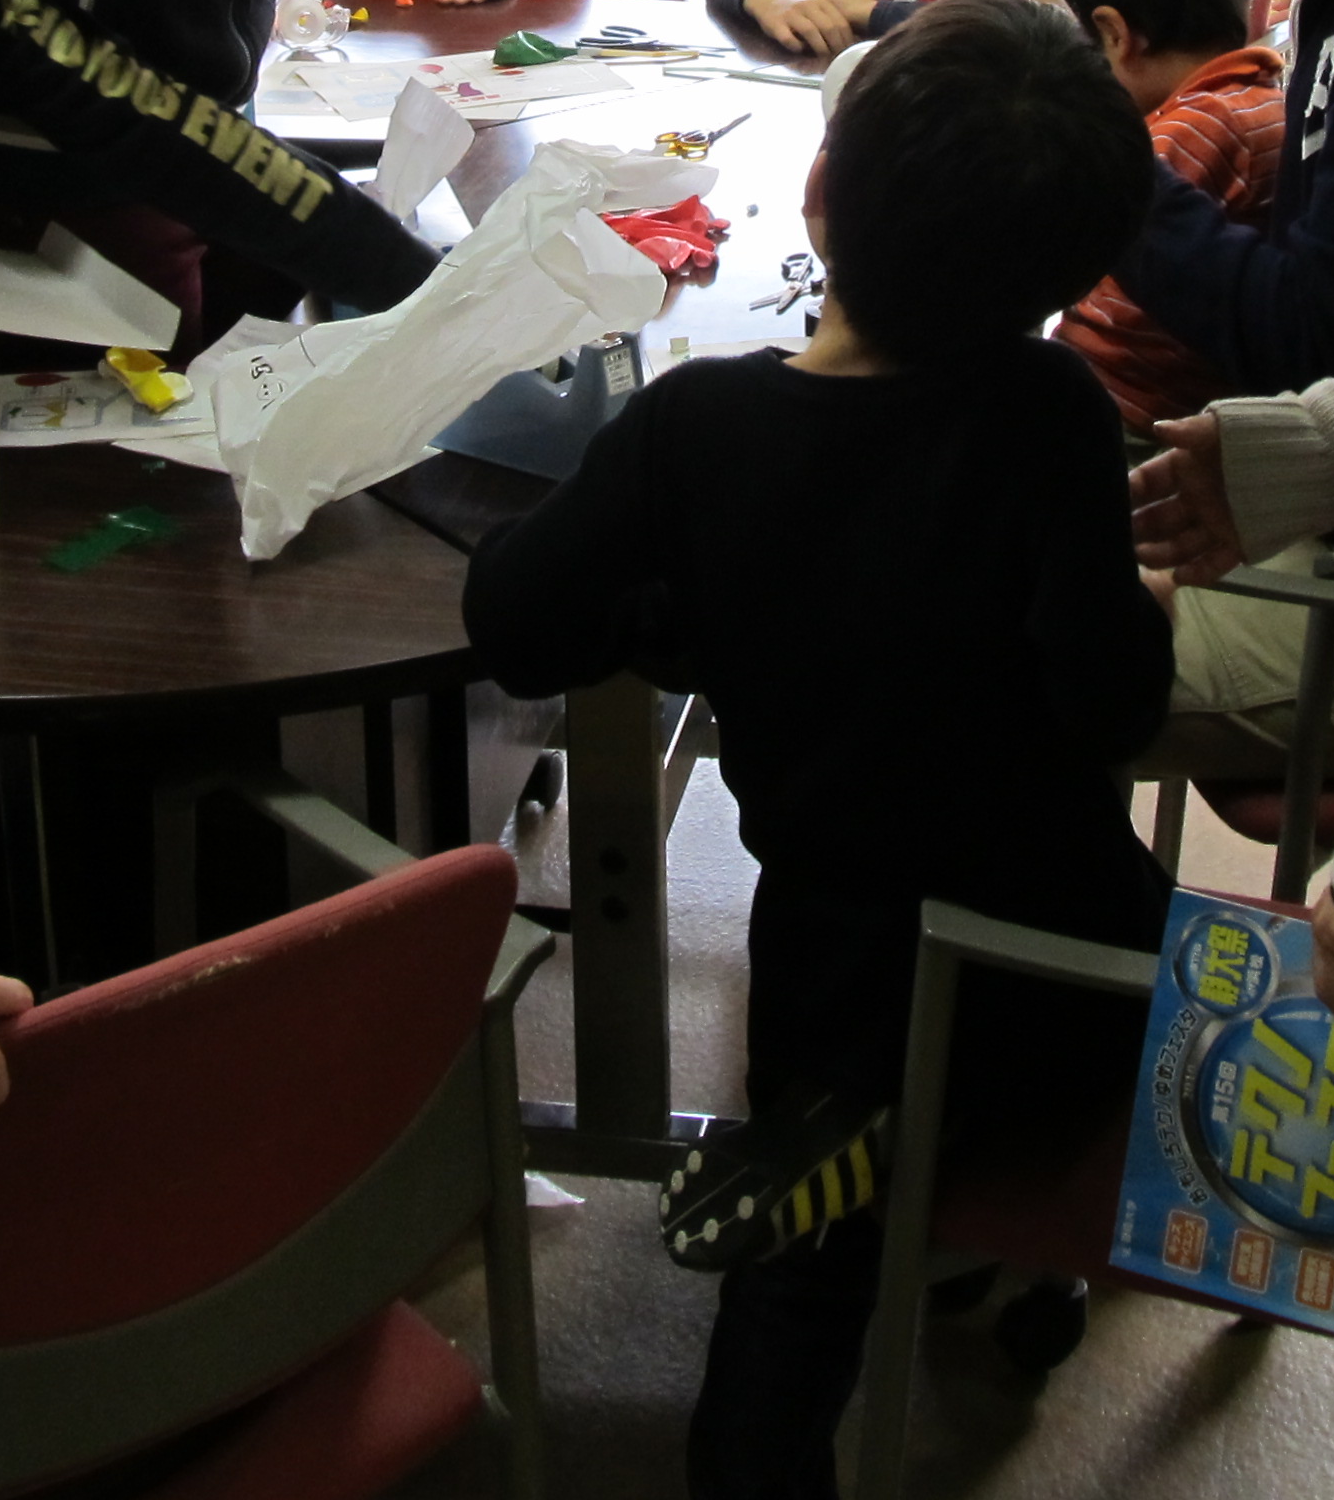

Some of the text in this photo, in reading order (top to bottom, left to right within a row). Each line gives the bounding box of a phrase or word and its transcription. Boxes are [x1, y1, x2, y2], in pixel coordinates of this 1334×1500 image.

[180, 94, 334, 223] EVENT
[1153, 1008, 1207, 1203] おもしろテクノゆめフェスタ
[1208, 1058, 1239, 1124] 第15回
[1230, 1019, 1314, 1186] テクノ
